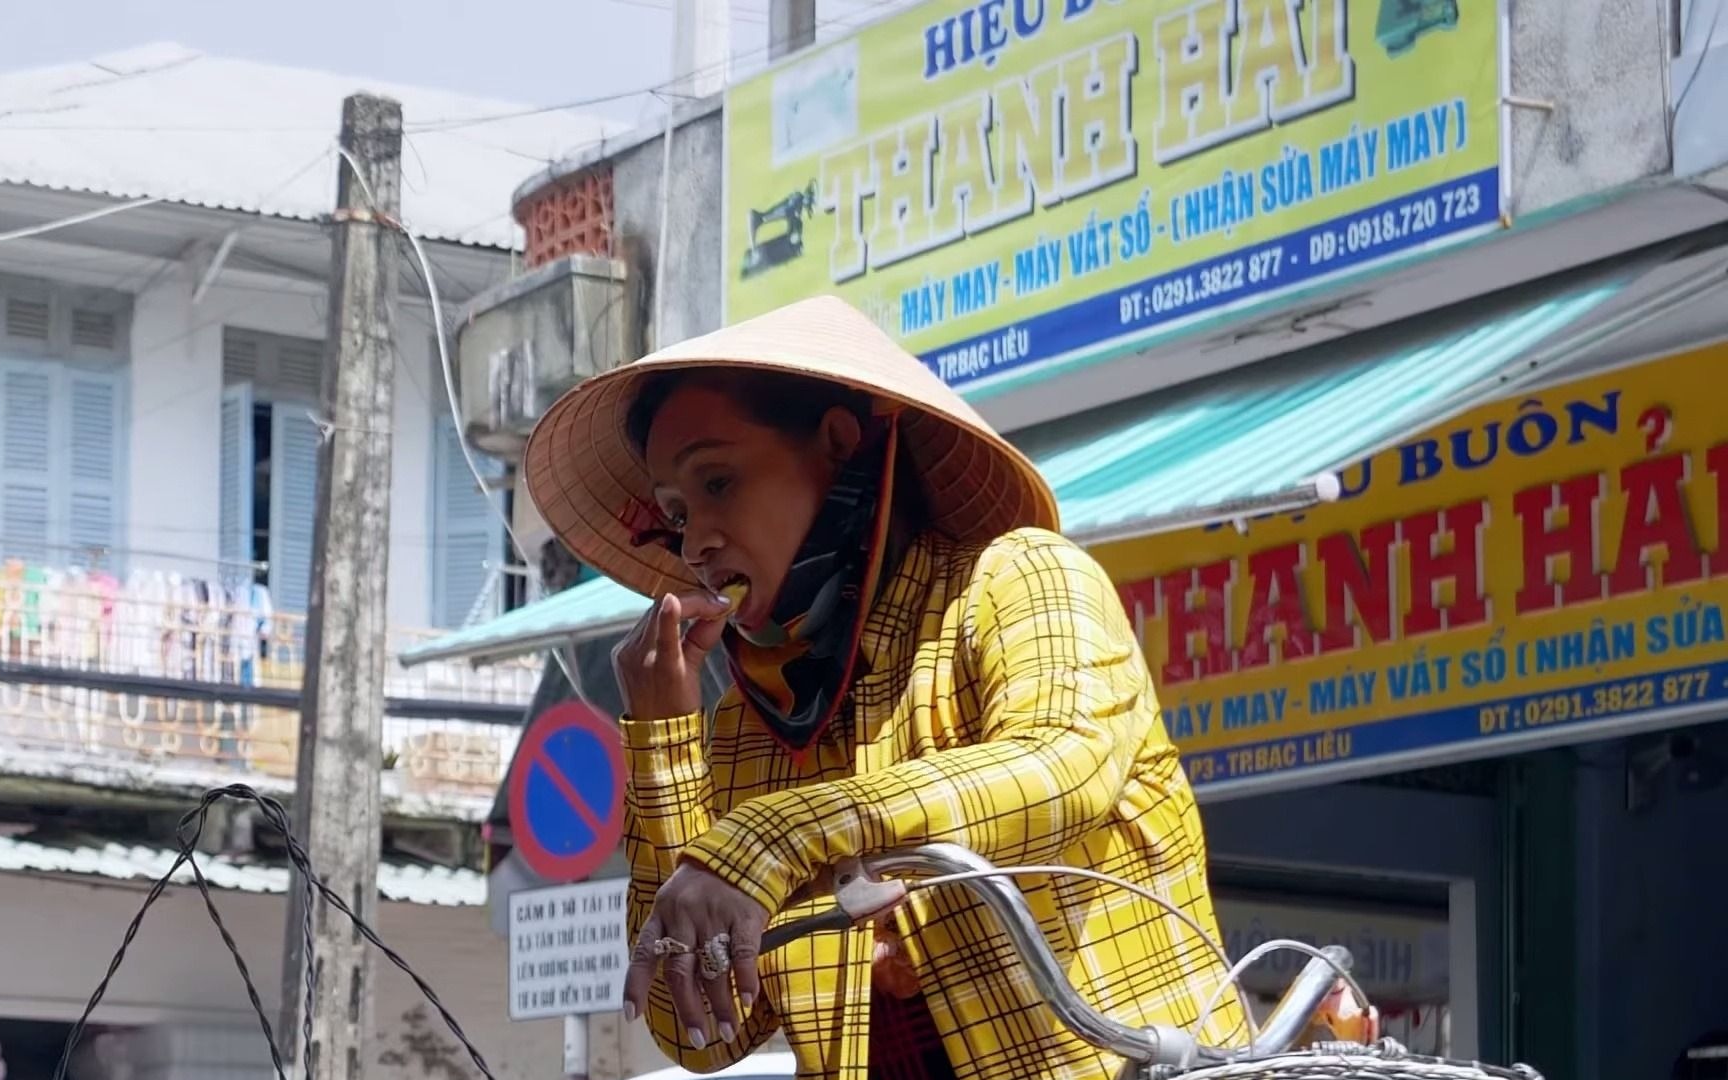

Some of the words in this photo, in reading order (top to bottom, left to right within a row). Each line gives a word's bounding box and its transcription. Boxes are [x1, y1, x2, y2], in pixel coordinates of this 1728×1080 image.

[821, 28, 1139, 283] THANH
[901, 276, 946, 335] MÁY
[952, 261, 1000, 317] MAY
[1014, 238, 1061, 296] MÁY
[1261, 145, 1313, 215] SỬA
[1320, 123, 1379, 194] MÁY
[1248, 247, 1283, 284] 877
[1442, 183, 1480, 222] 723
[993, 326, 1030, 365] LIÊU
[1399, 391, 1622, 485] BUÔN
[1222, 687, 1287, 731] MAY
[1310, 664, 1377, 714] MÁY
[1646, 595, 1726, 654] SỬA
[1662, 670, 1711, 702] 877
[1303, 728, 1353, 764] LIÊU
